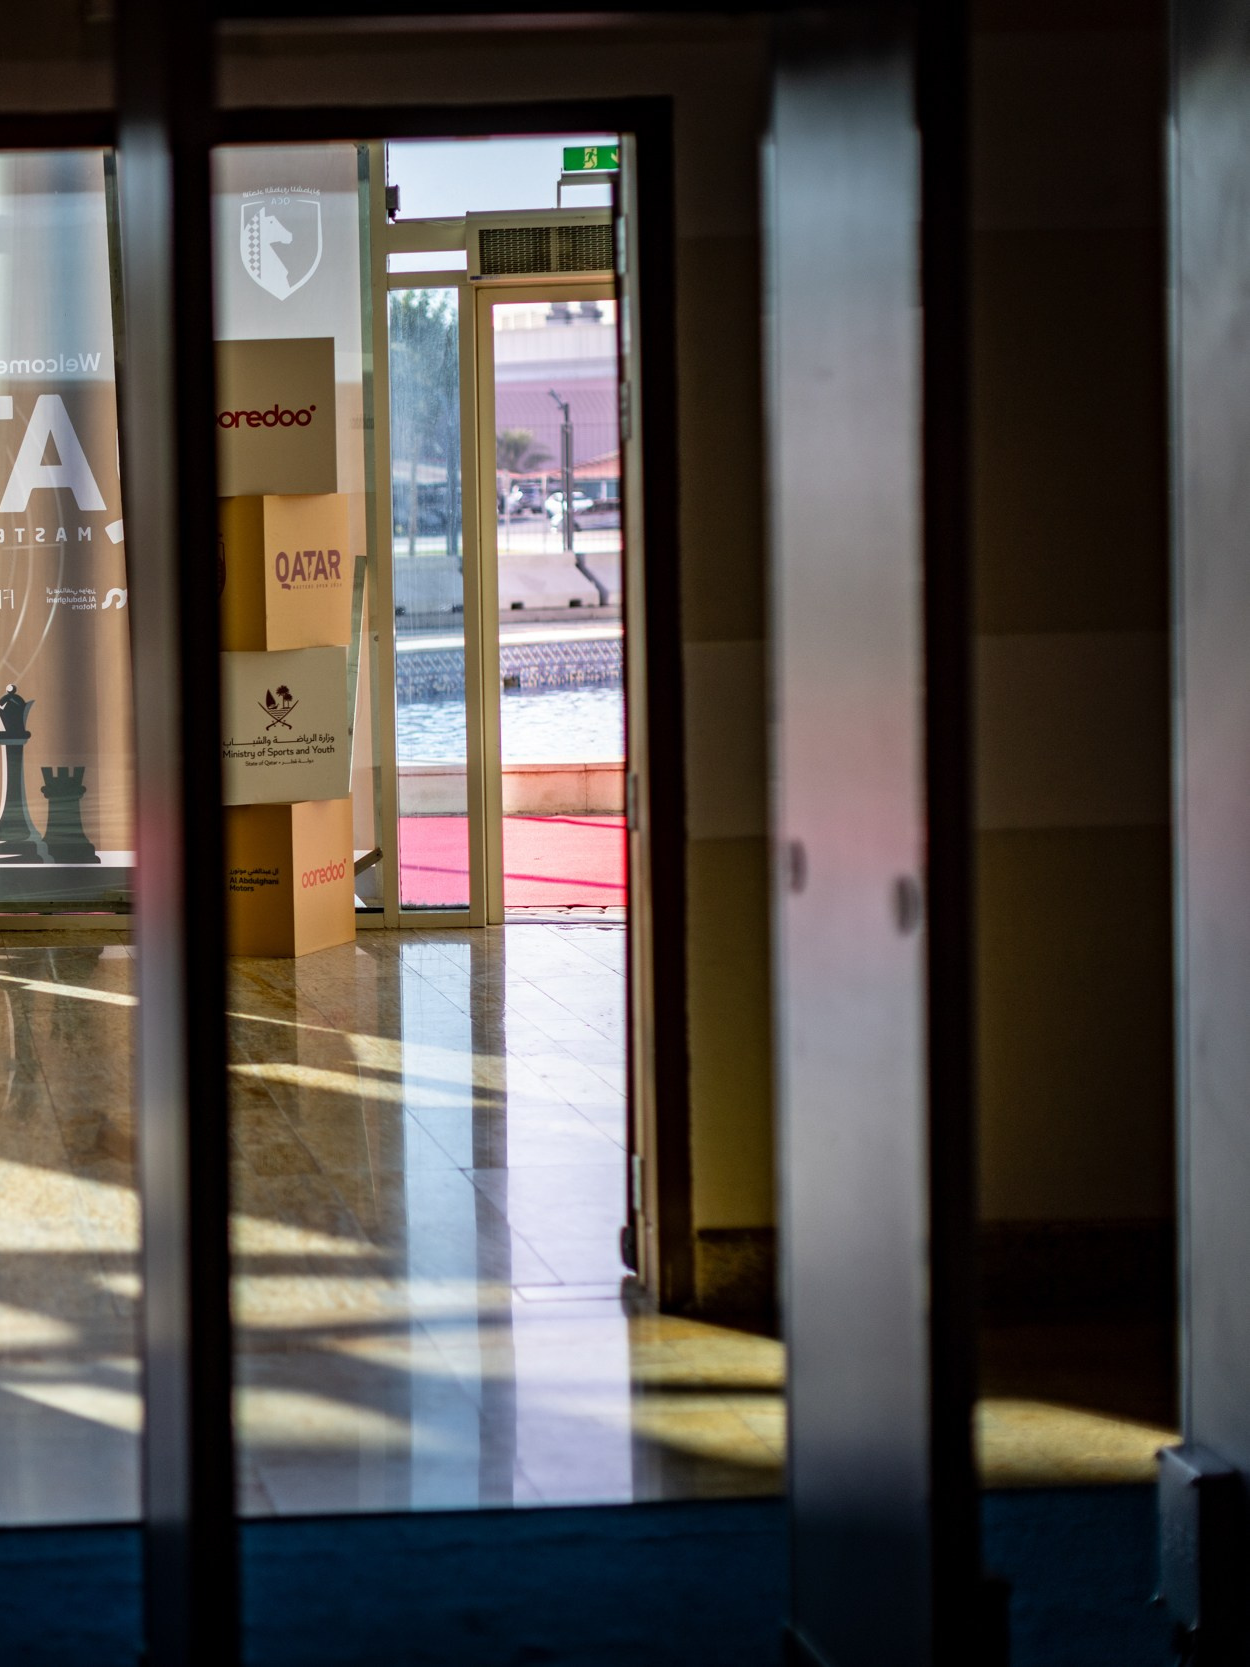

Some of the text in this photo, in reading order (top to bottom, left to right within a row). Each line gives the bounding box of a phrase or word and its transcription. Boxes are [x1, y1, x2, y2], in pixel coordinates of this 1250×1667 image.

[216, 403, 317, 429] oredoo
[275, 550, 341, 590] QATAR
[272, 734, 317, 744] الرياضة
[318, 733, 335, 743] وزارة
[222, 745, 335, 760] Ministry of Sports and Youth
[302, 858, 347, 888] ooredoo
[238, 877, 279, 886] Abdulghani
